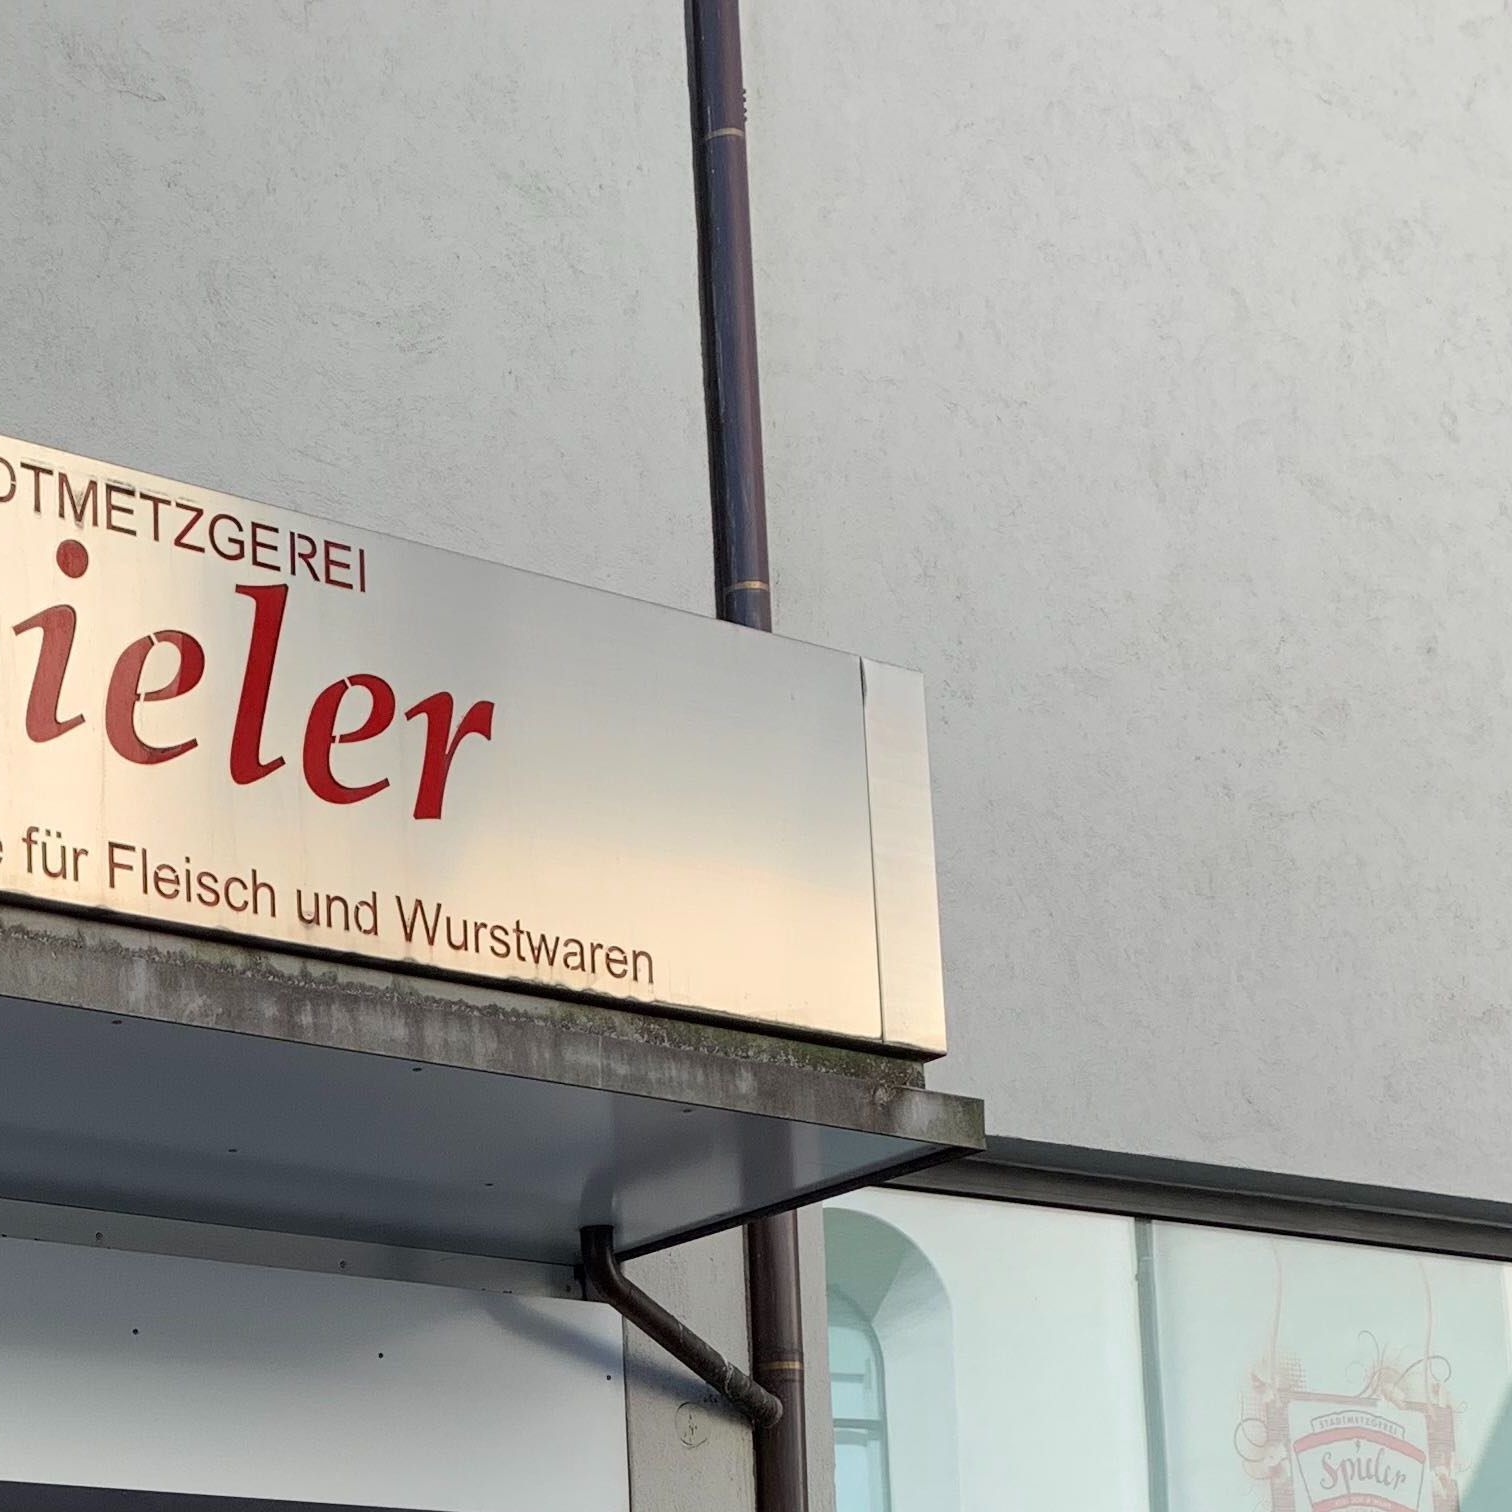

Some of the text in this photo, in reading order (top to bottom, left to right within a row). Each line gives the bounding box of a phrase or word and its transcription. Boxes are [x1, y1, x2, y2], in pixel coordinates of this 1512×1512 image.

[22, 823, 89, 883] für
[107, 842, 278, 919] Fleisch
[294, 885, 381, 937] und
[395, 895, 656, 984] Wurstwaren
